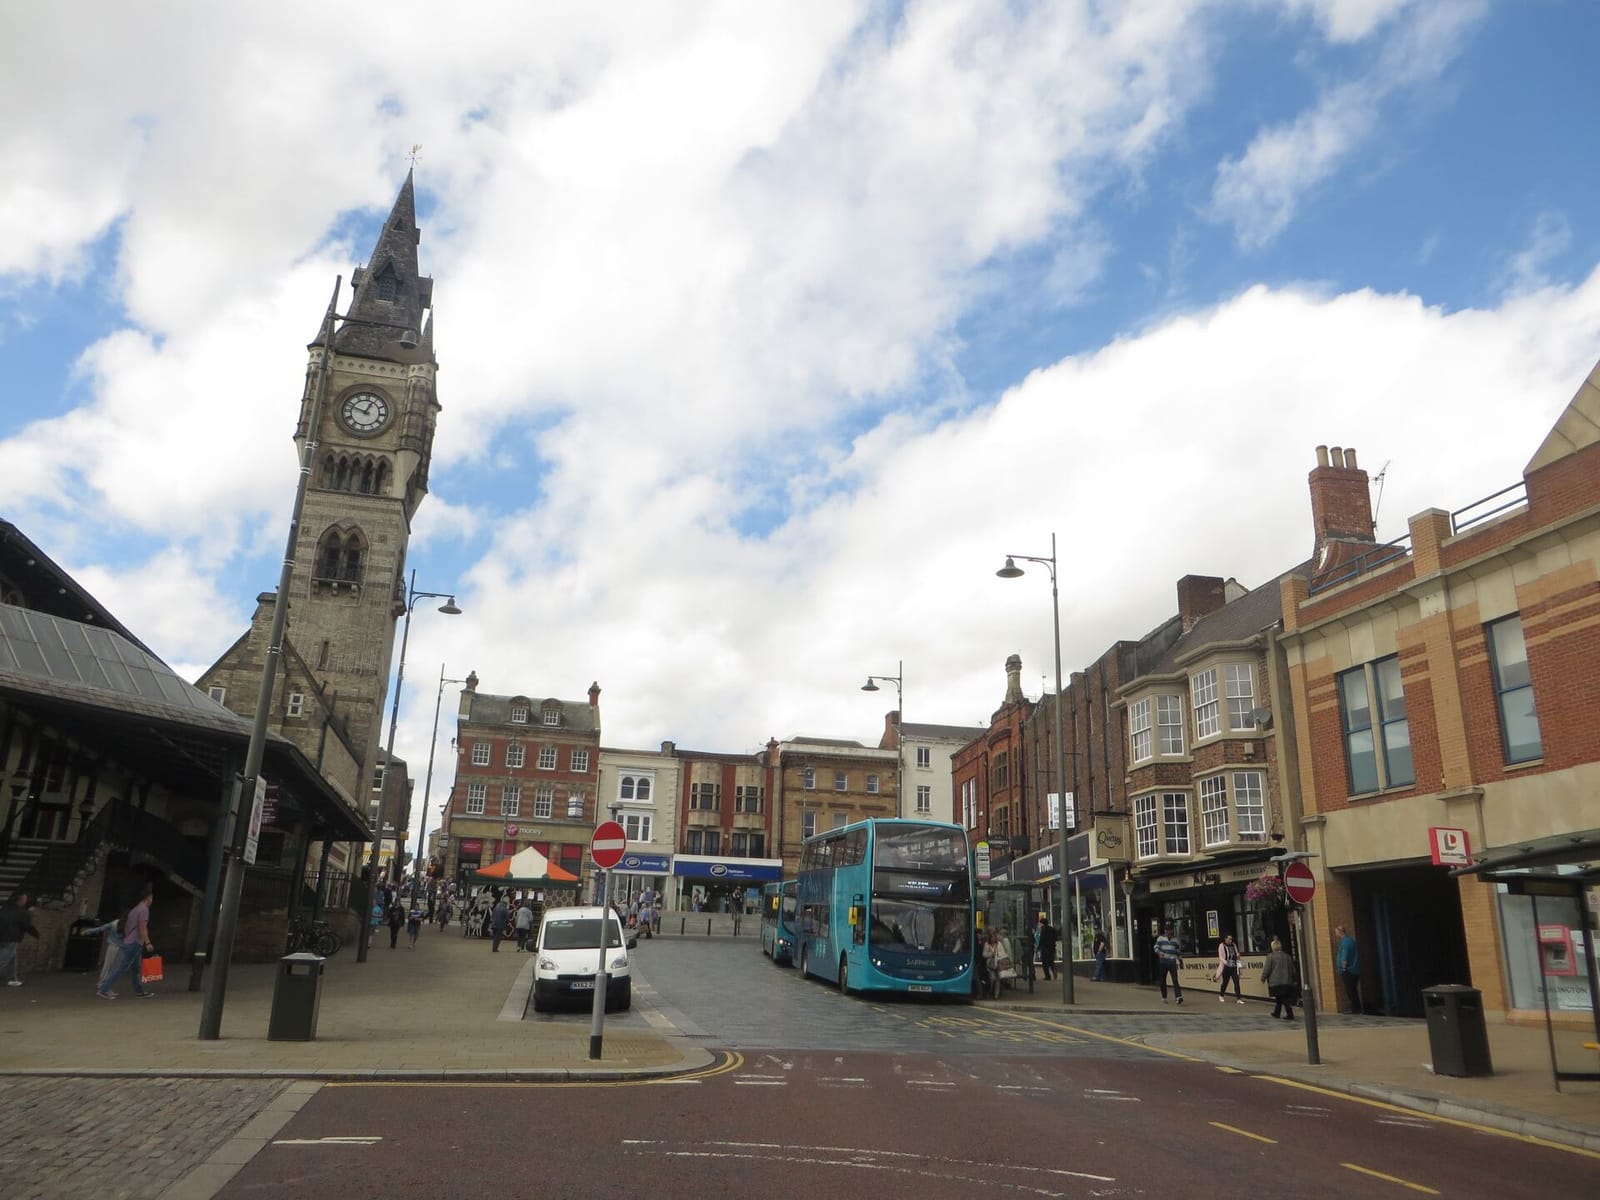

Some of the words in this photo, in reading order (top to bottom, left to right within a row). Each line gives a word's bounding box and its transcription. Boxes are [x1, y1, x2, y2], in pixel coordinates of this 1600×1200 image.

[519, 827, 543, 836] money
[1037, 853, 1054, 873] YMCA
[1185, 962, 1205, 970] SPORTS
